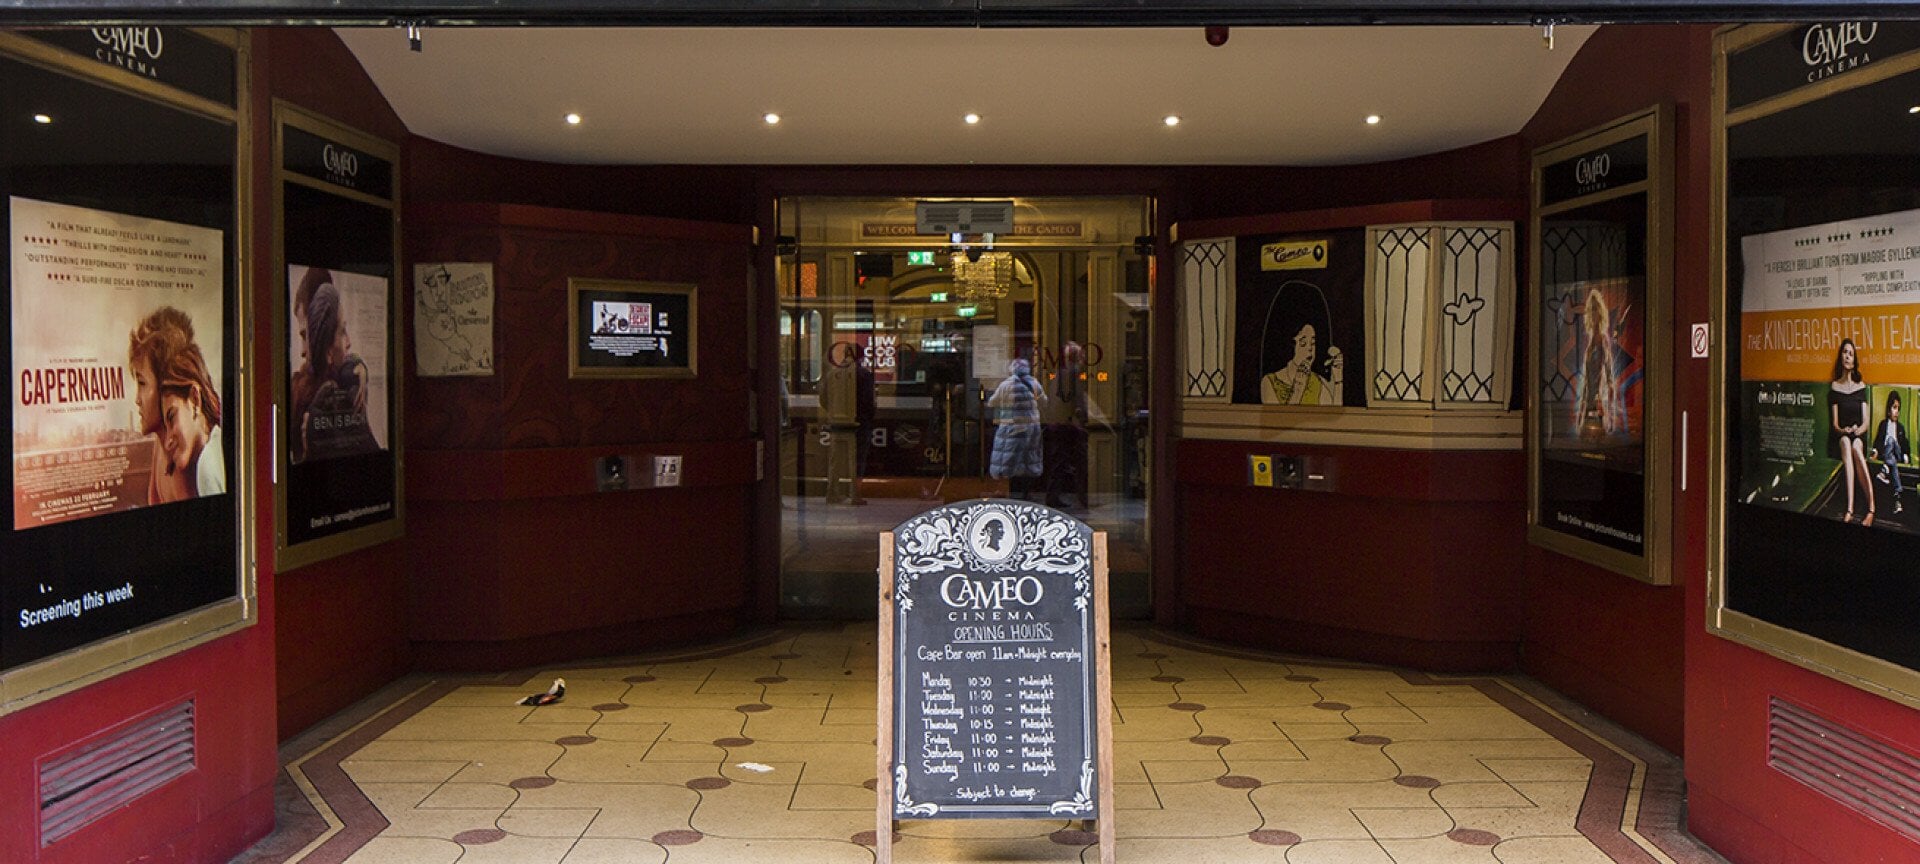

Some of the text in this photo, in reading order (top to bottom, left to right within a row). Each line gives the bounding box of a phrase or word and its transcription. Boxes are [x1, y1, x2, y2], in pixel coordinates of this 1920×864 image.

[1802, 22, 1878, 66] CAMEO
[96, 48, 157, 77] CINEMA
[1807, 52, 1870, 83] CINEMA
[323, 144, 358, 177] CAMEO
[1575, 153, 1610, 185] CAMEO
[57, 222, 73, 231] FILM
[76, 224, 91, 232] THAT
[140, 232, 154, 241] LIKE
[93, 242, 107, 250] WITH
[150, 249, 162, 257] AND
[1824, 254, 1839, 268] TURN
[1841, 252, 1859, 266] FROM
[1860, 249, 1886, 264] MAGGIE
[113, 277, 134, 286] OSCAR
[1747, 334, 1762, 350] THE
[1764, 316, 1874, 350] KINDERGARTEN
[21, 366, 124, 406] CAPERNAUM
[940, 573, 1044, 610] CAMEO
[19, 582, 134, 628] Screening this week
[948, 611, 1035, 621] CINEMA
[954, 622, 1053, 640] OPENING HOURS
[944, 644, 962, 660] Bar
[965, 649, 986, 662] open
[1050, 648, 1082, 663] everyday
[922, 671, 952, 690] Monday
[1018, 674, 1054, 688] Midnight
[922, 689, 956, 703] Tuesday
[1018, 688, 1055, 703] Midnight
[921, 701, 964, 719] Wednesday
[1020, 703, 1052, 719] Midnight
[921, 718, 958, 734] Thursday
[1020, 717, 1054, 734] Midnight
[924, 731, 951, 748] Friday
[1021, 731, 1056, 747] Midnight
[922, 744, 964, 763] Saturday
[1021, 746, 1054, 763] Midnight
[922, 759, 958, 782] Sunday
[1022, 760, 1056, 777] Midnight
[956, 785, 992, 801] Subject
[994, 784, 1005, 798] to
